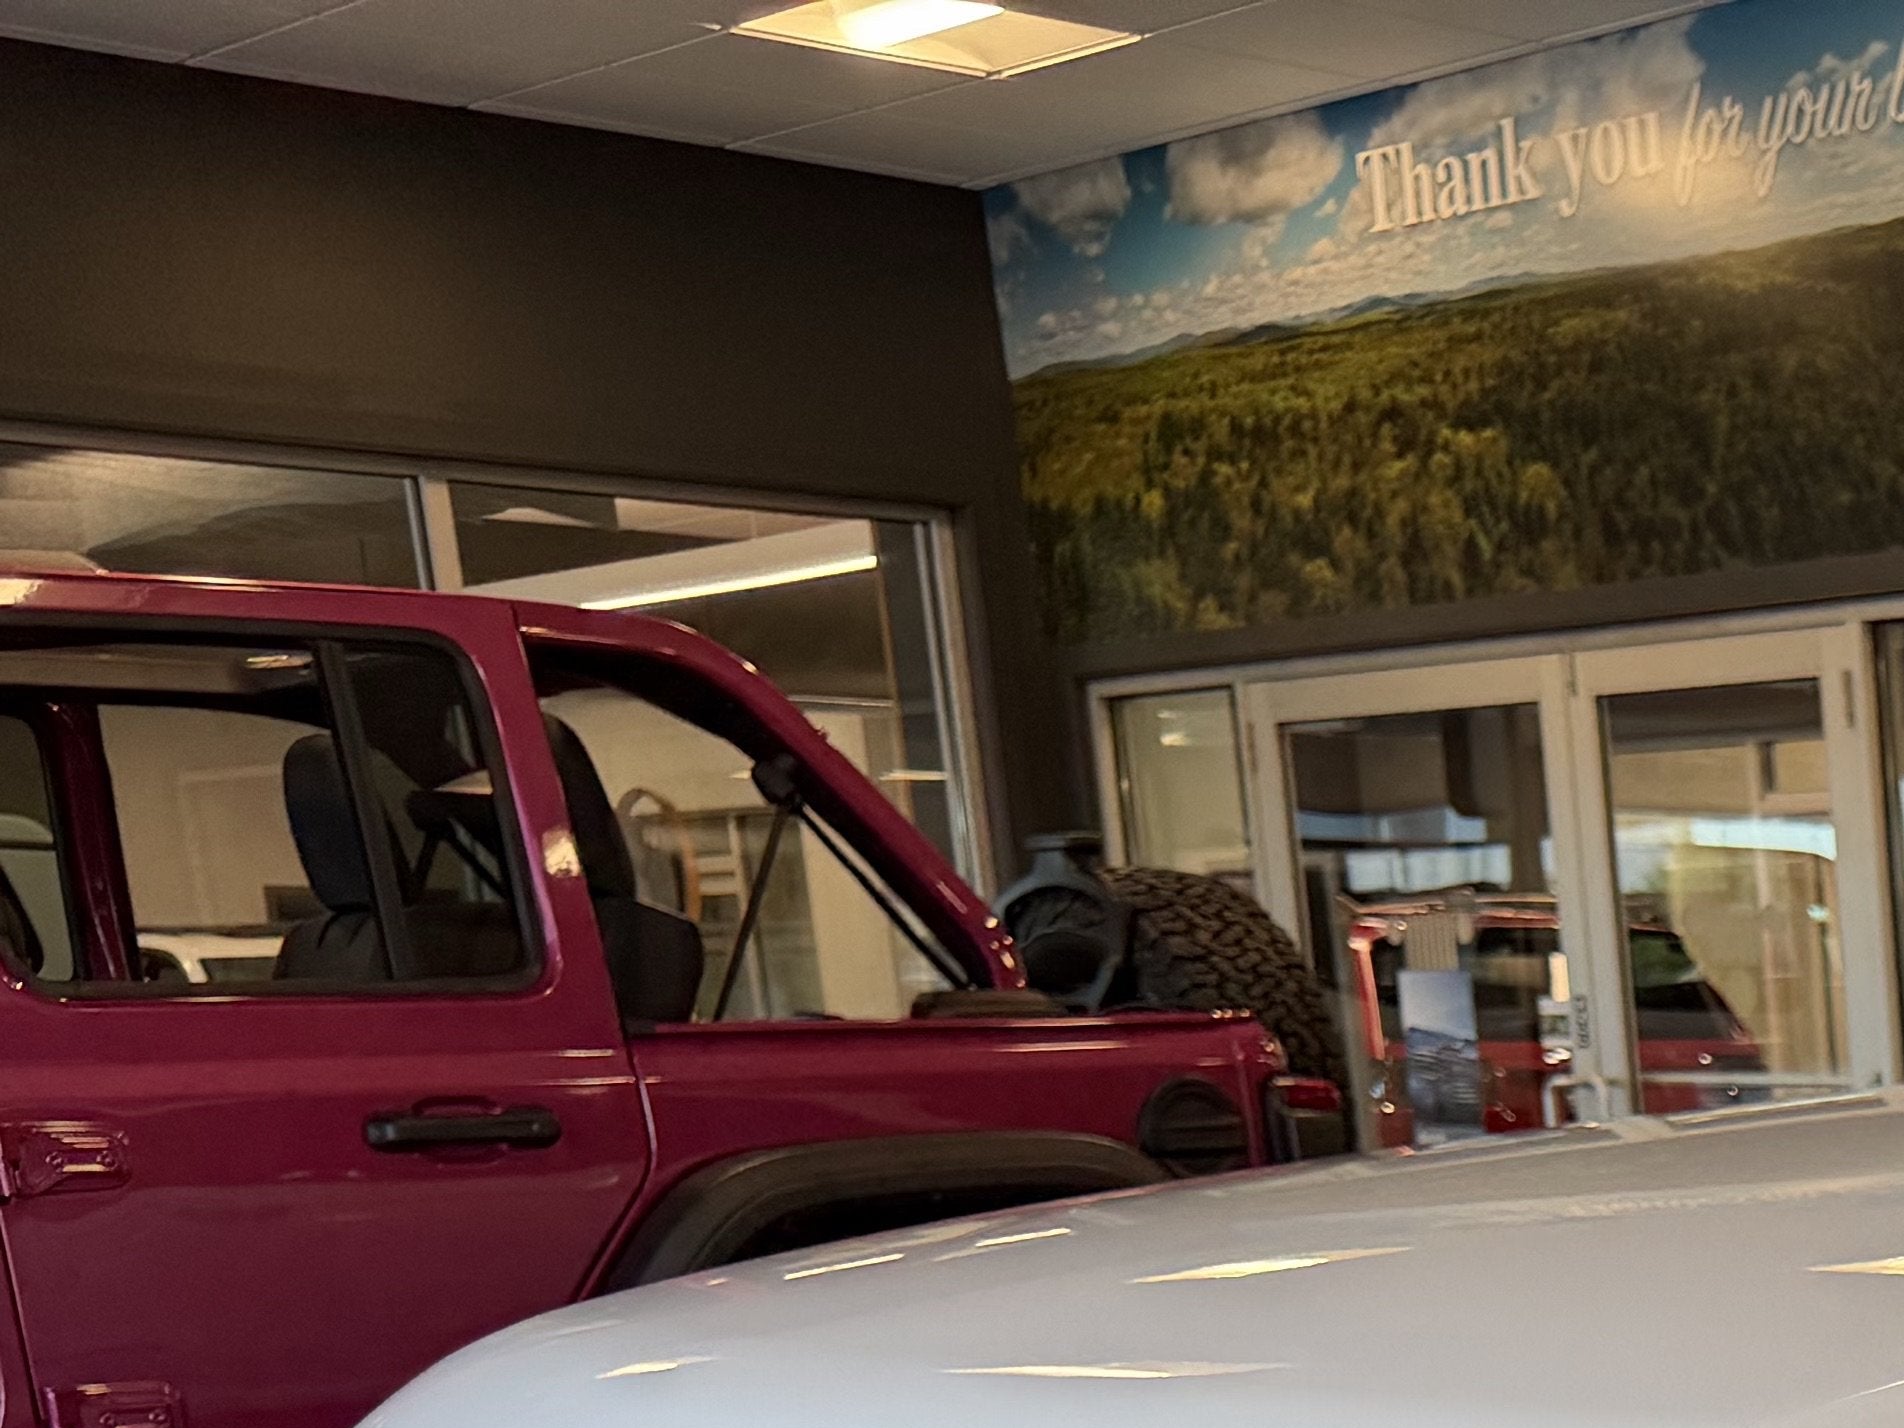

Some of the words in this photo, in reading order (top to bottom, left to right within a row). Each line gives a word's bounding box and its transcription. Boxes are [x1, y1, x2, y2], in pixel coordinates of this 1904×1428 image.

[1356, 117, 1541, 234] Thank
[1557, 109, 1666, 217] you
[1679, 82, 1752, 206] for
[1756, 74, 1879, 197] your
